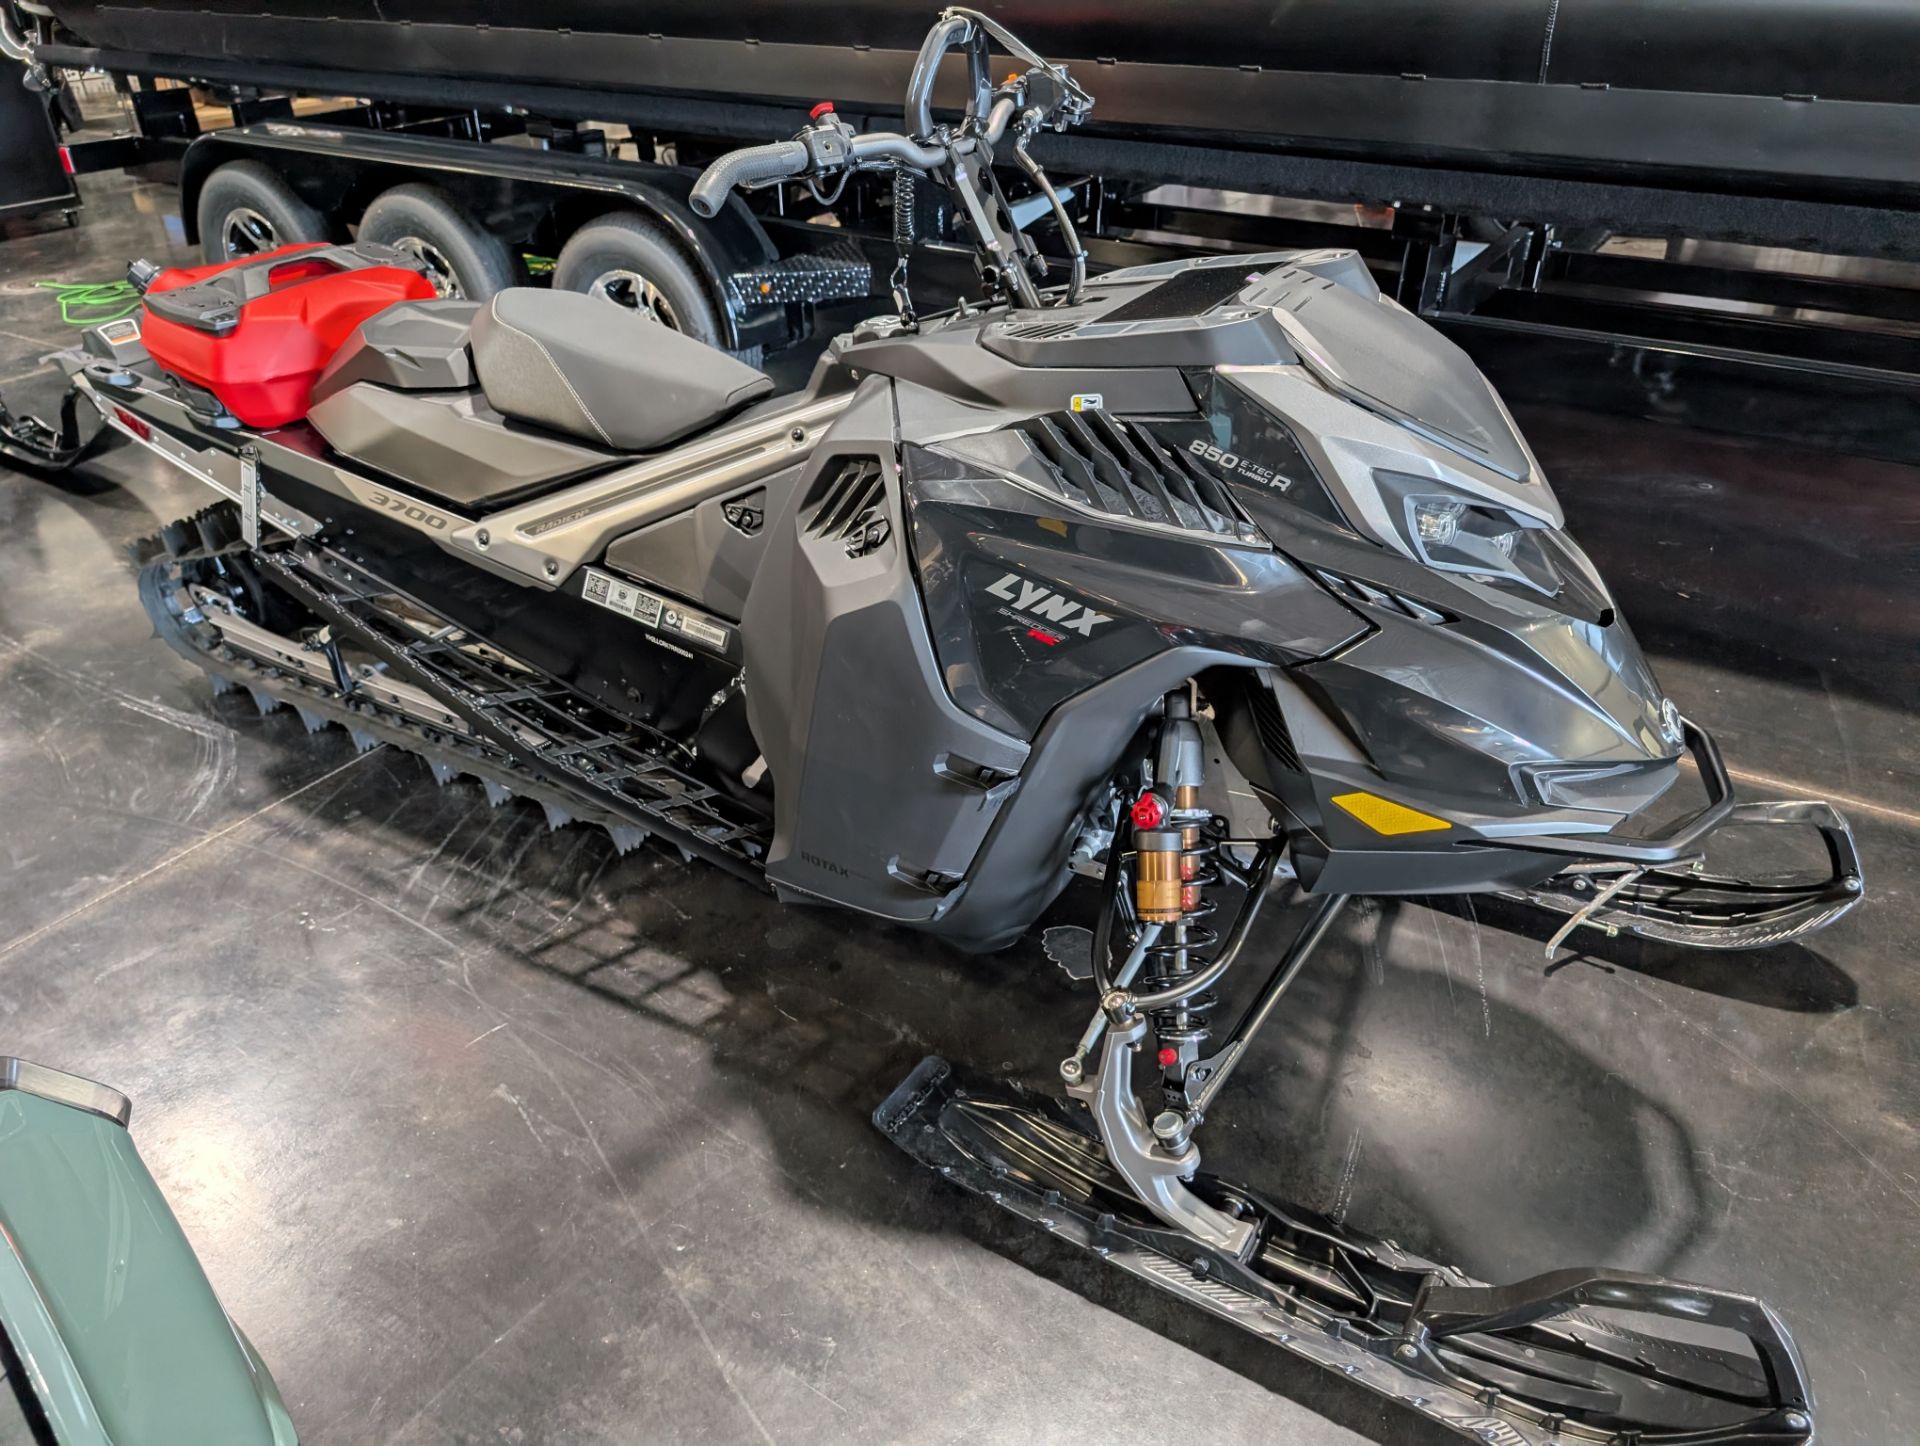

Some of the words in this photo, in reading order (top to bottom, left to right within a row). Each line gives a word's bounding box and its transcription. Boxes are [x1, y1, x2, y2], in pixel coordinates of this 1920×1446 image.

[1188, 439, 1240, 469] 850
[1240, 459, 1274, 478] E-TEC
[1236, 467, 1268, 484] TURBO
[1269, 474, 1292, 492] R
[368, 491, 447, 530] 3700
[984, 572, 1115, 637] LYNX
[996, 606, 1067, 641] SHREDDER
[801, 850, 849, 878] ROTAX
